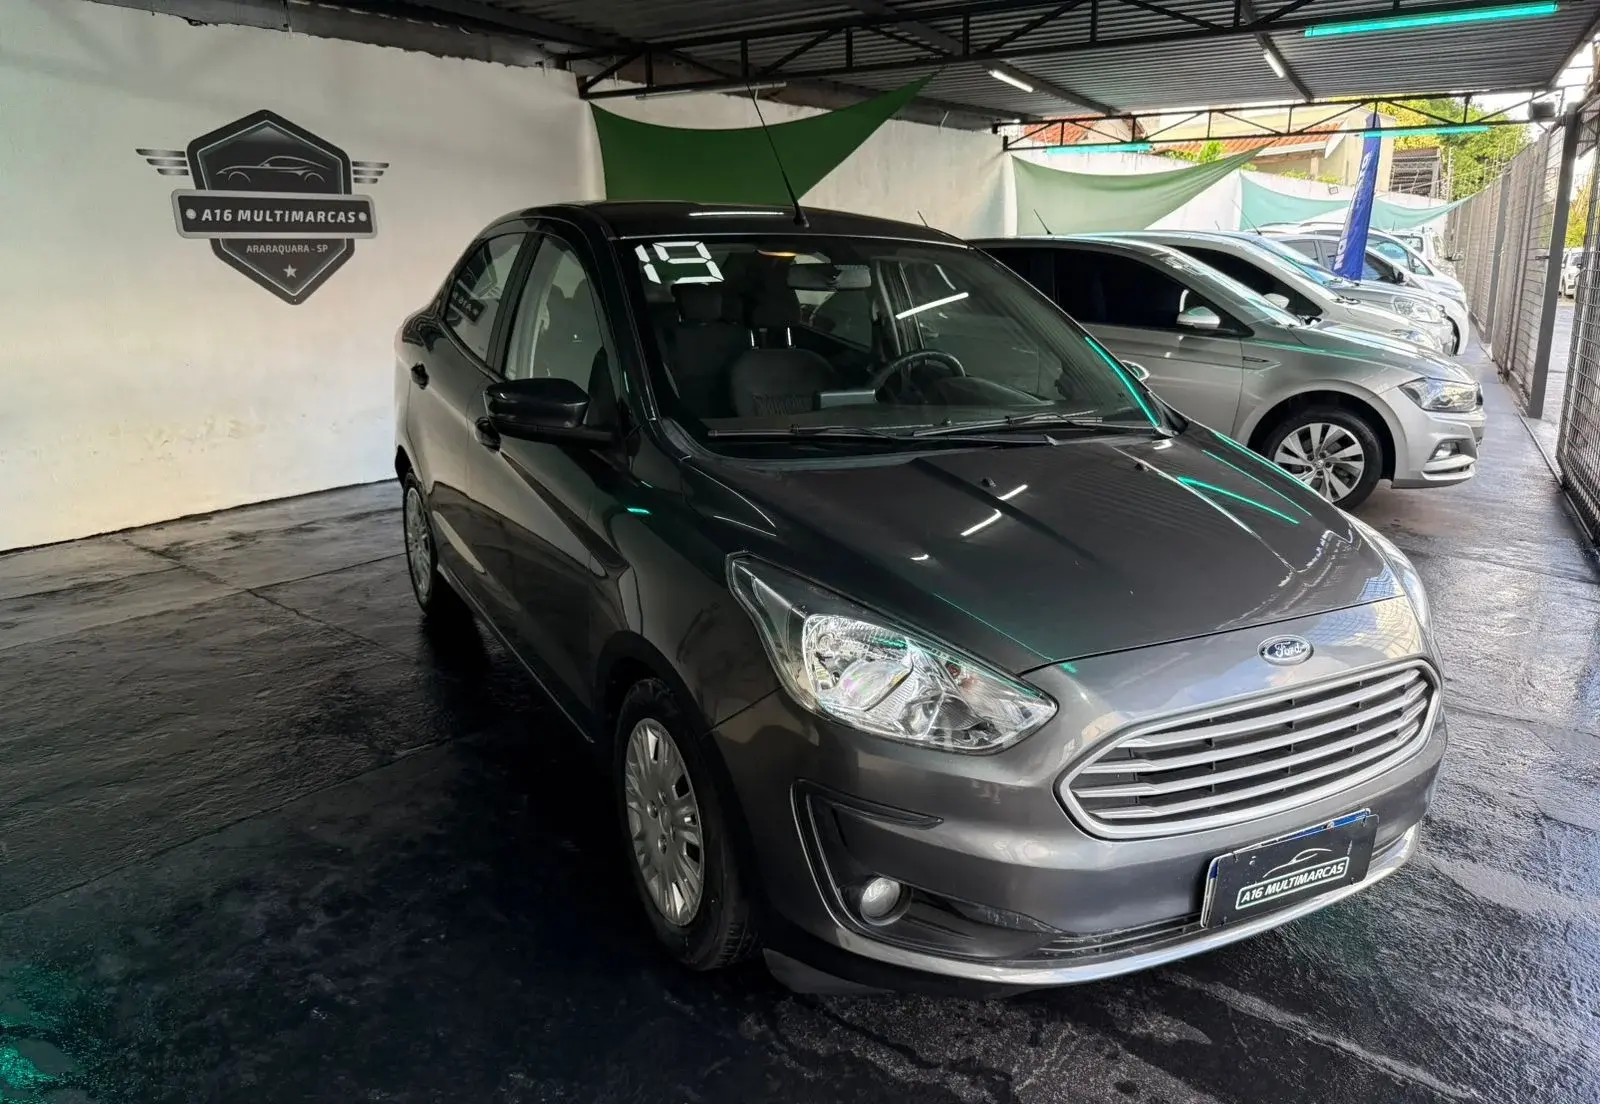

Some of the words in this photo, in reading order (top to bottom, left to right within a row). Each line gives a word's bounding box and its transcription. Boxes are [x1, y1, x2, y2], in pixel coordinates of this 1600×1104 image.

[201, 208, 233, 222] A16
[237, 209, 356, 223] MULTIMARCAS
[246, 244, 310, 255] ARARAQUARA
[316, 244, 328, 253] SP
[634, 241, 725, 284] 19
[1274, 641, 1303, 658] Ford
[1241, 885, 1262, 903] A16
[1264, 862, 1345, 896] MULTIMARCAS
